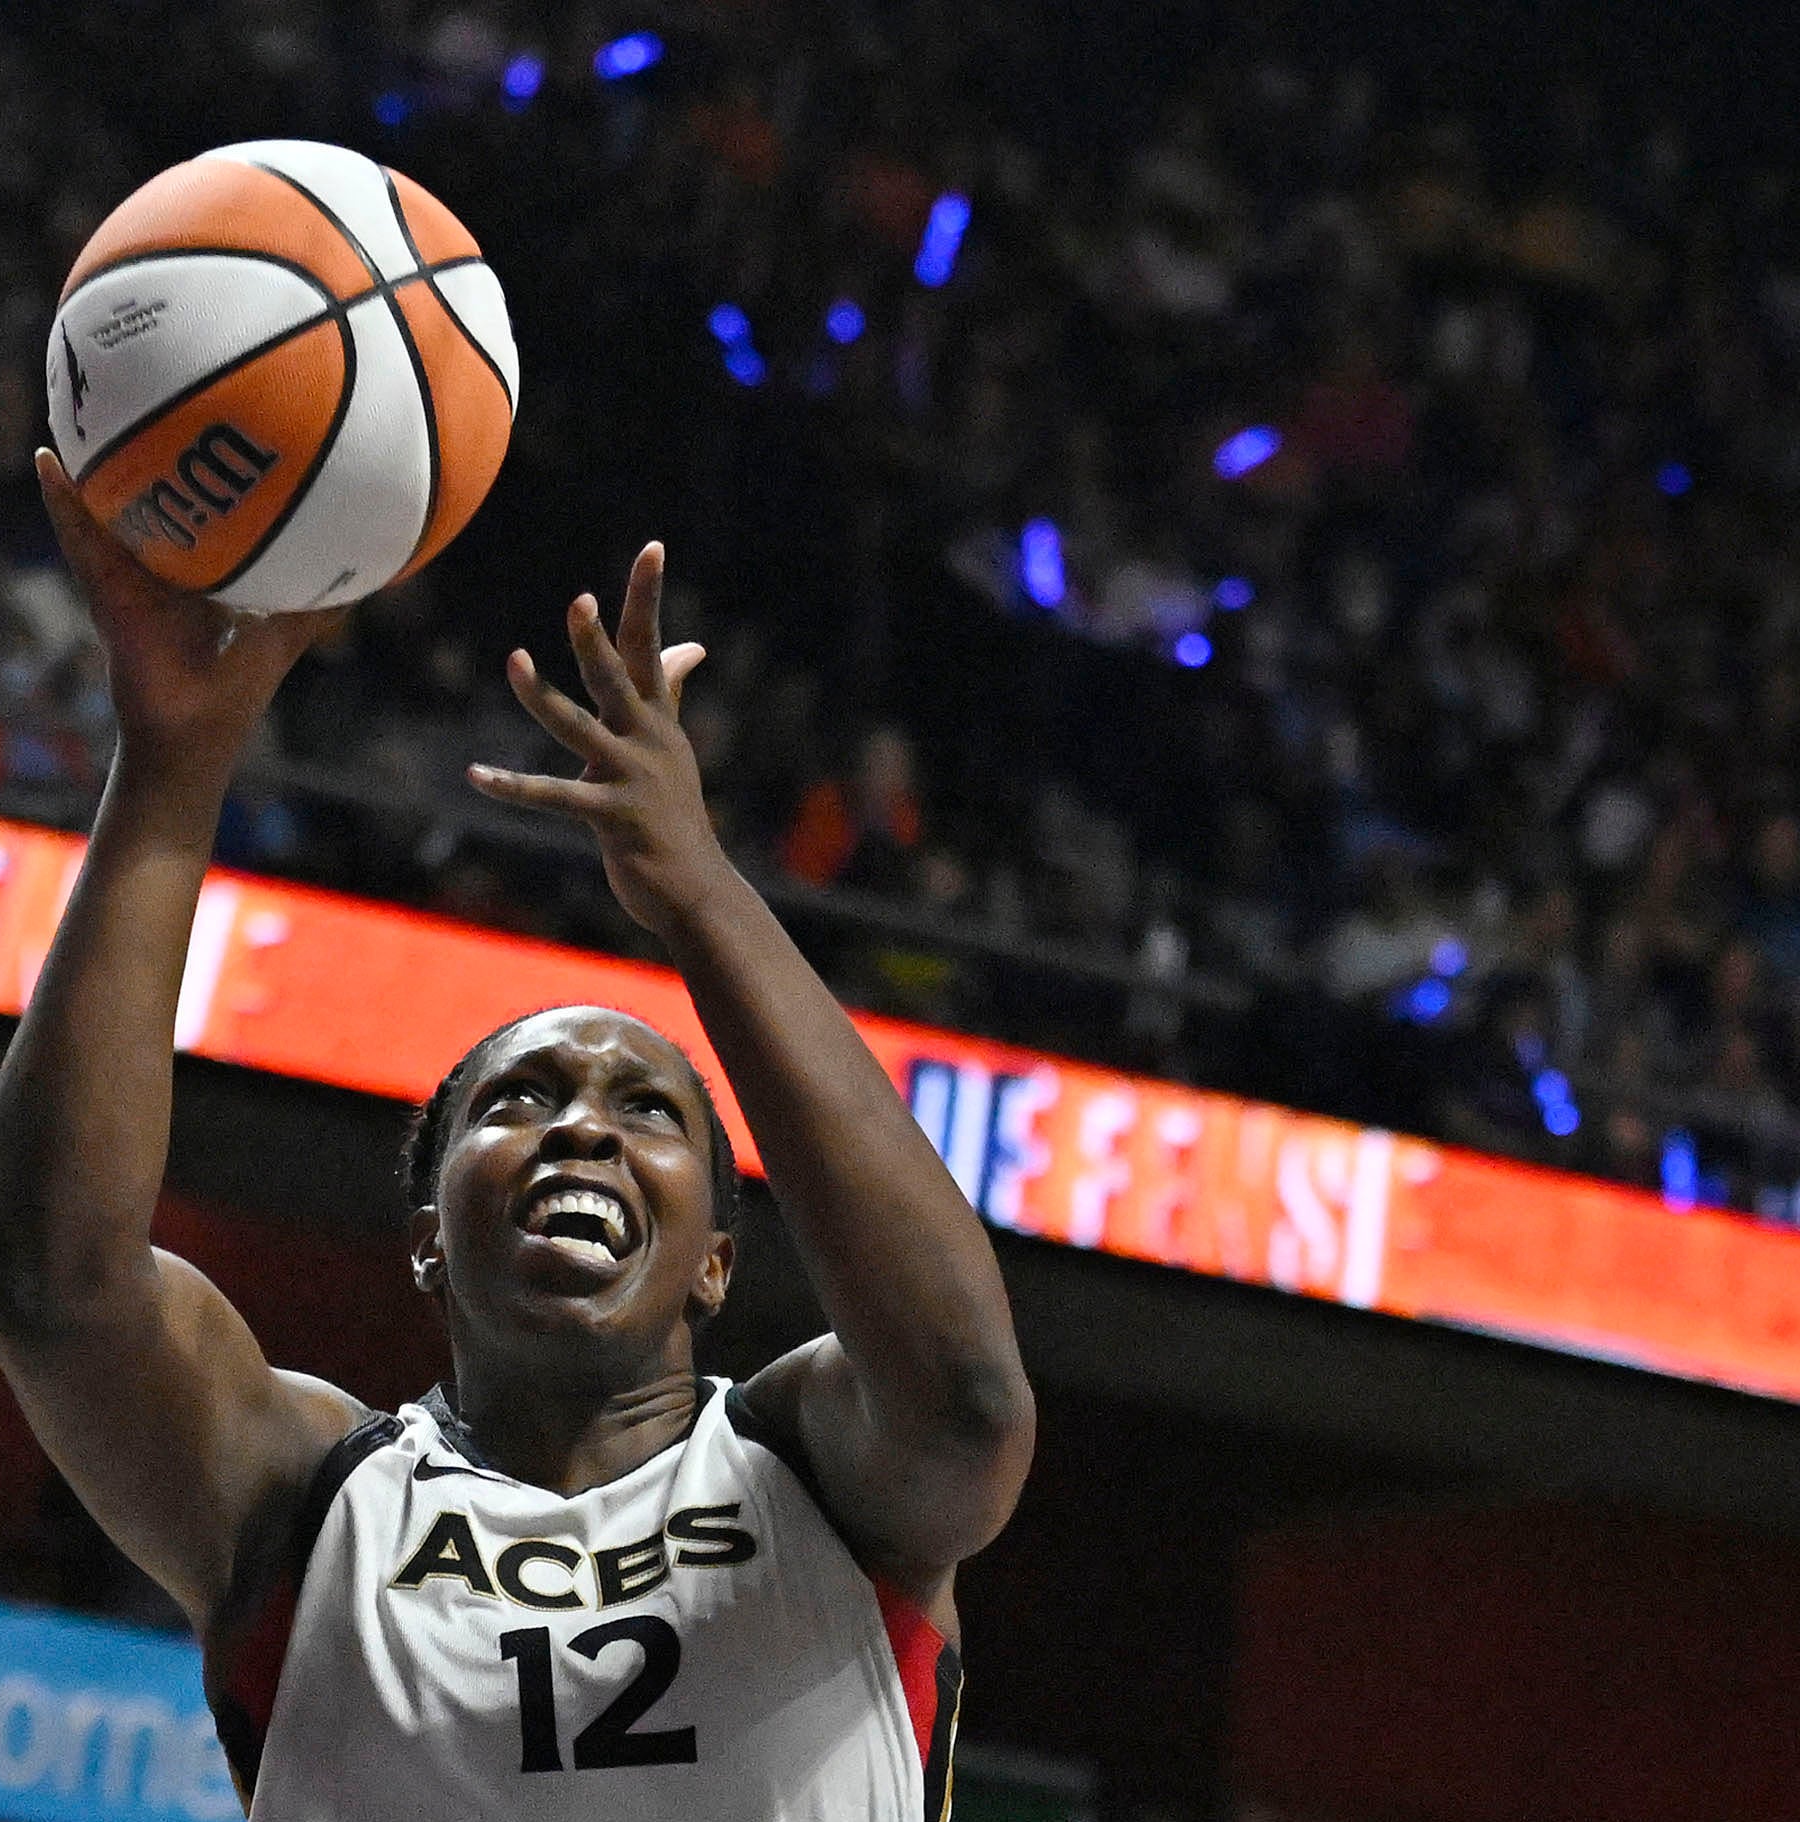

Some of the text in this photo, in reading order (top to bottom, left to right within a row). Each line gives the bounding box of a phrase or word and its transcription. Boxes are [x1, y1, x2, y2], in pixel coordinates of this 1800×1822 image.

[118, 423, 282, 550] Wil
[388, 1503, 759, 1612] ACES
[500, 1615, 698, 1773] 12
